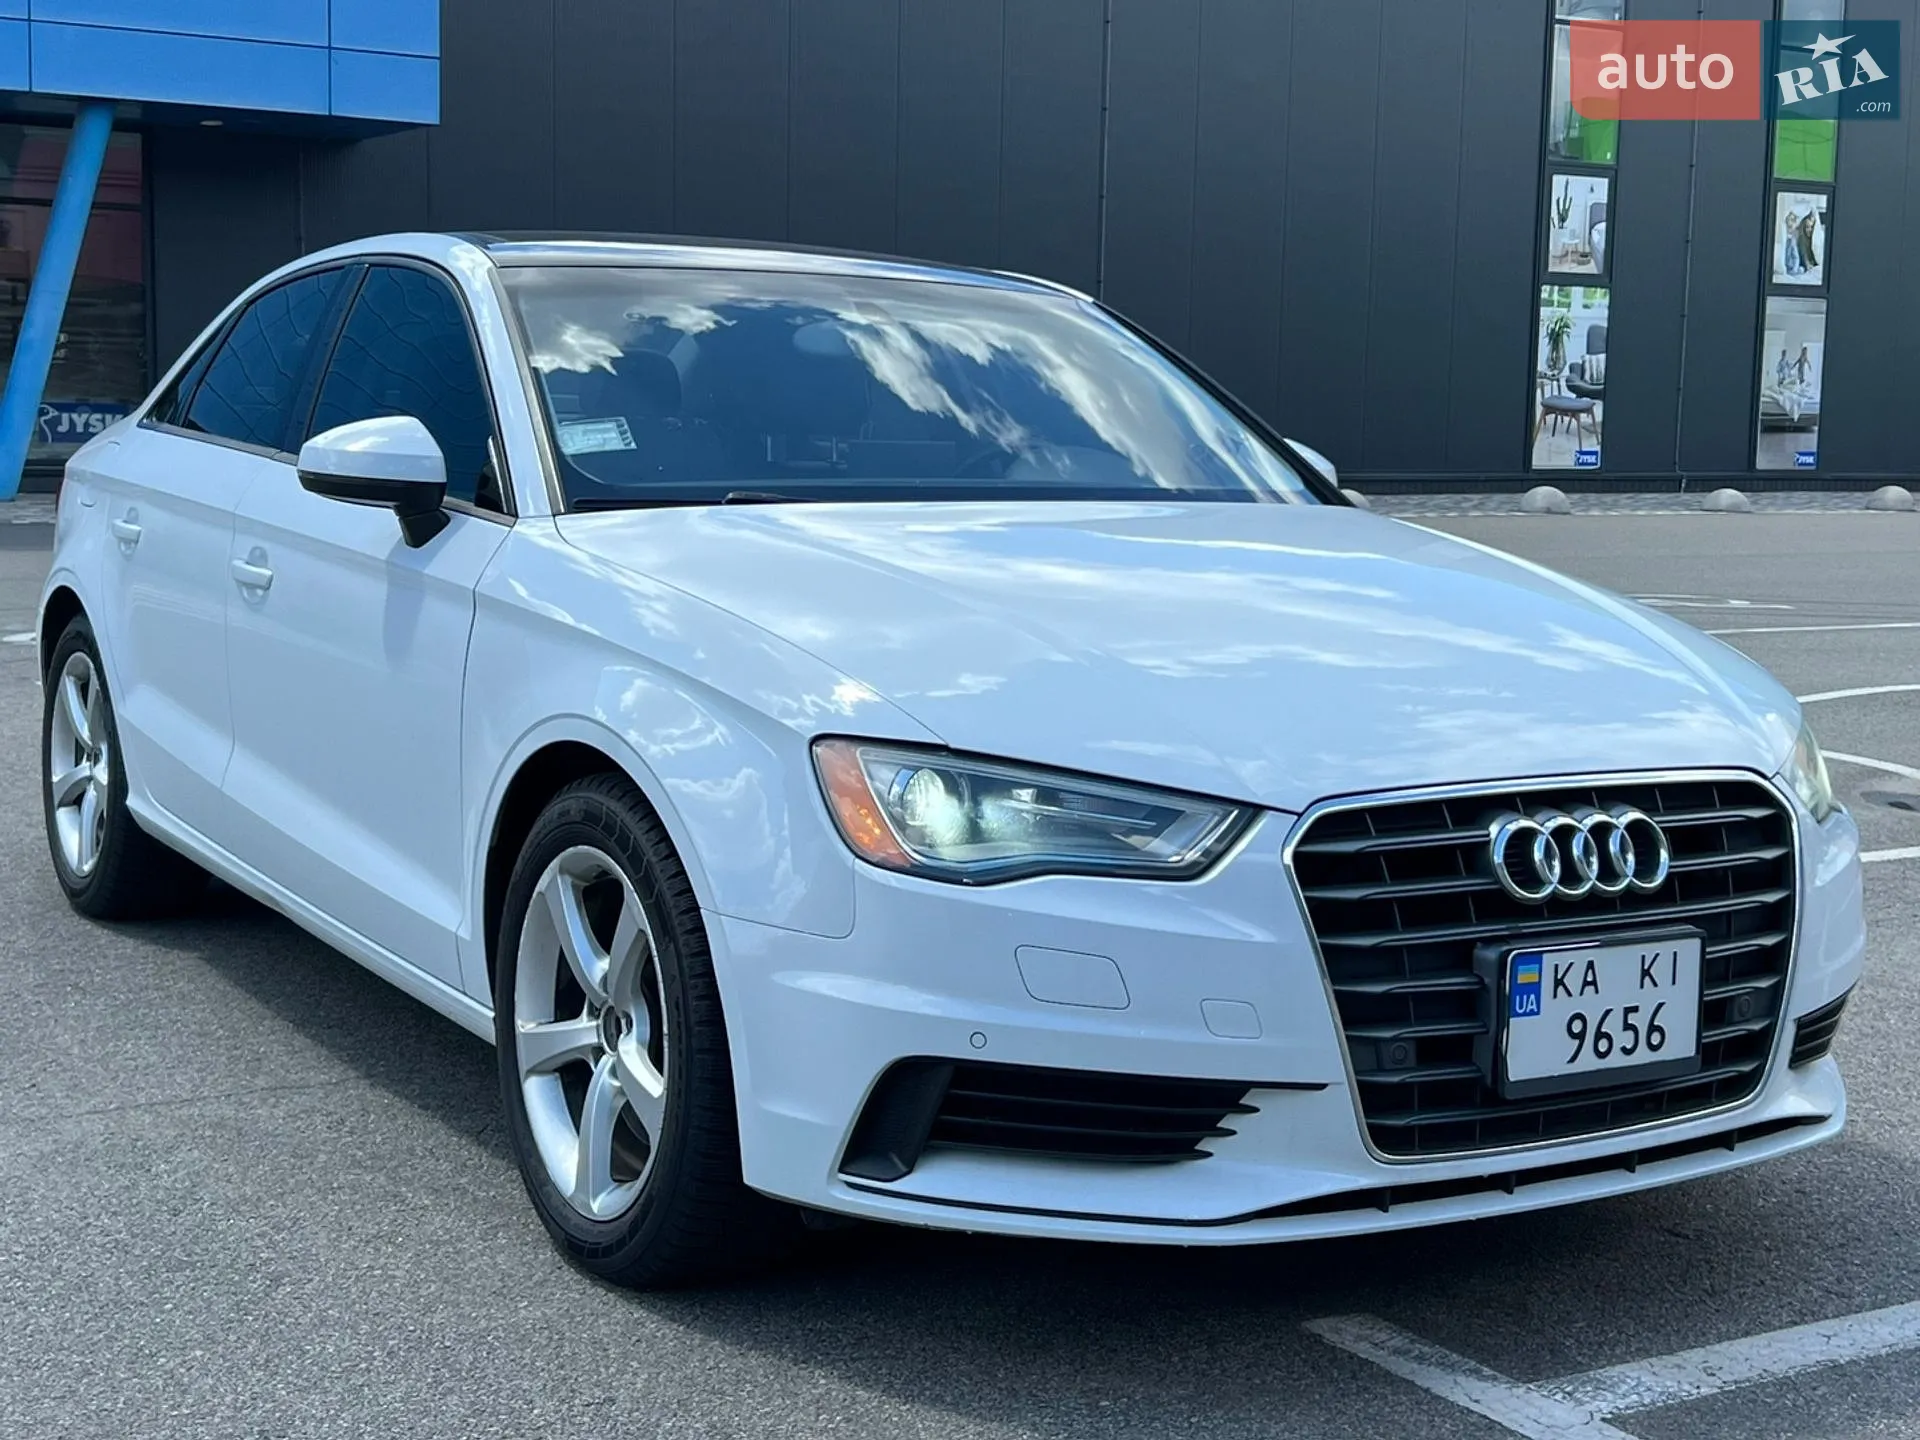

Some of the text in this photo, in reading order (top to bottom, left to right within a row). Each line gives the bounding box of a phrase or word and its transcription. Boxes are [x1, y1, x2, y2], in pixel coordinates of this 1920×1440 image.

[1553, 951, 1678, 999] KA KI
[1515, 994, 1538, 1014] UA
[1565, 1001, 1667, 1065] 9656
